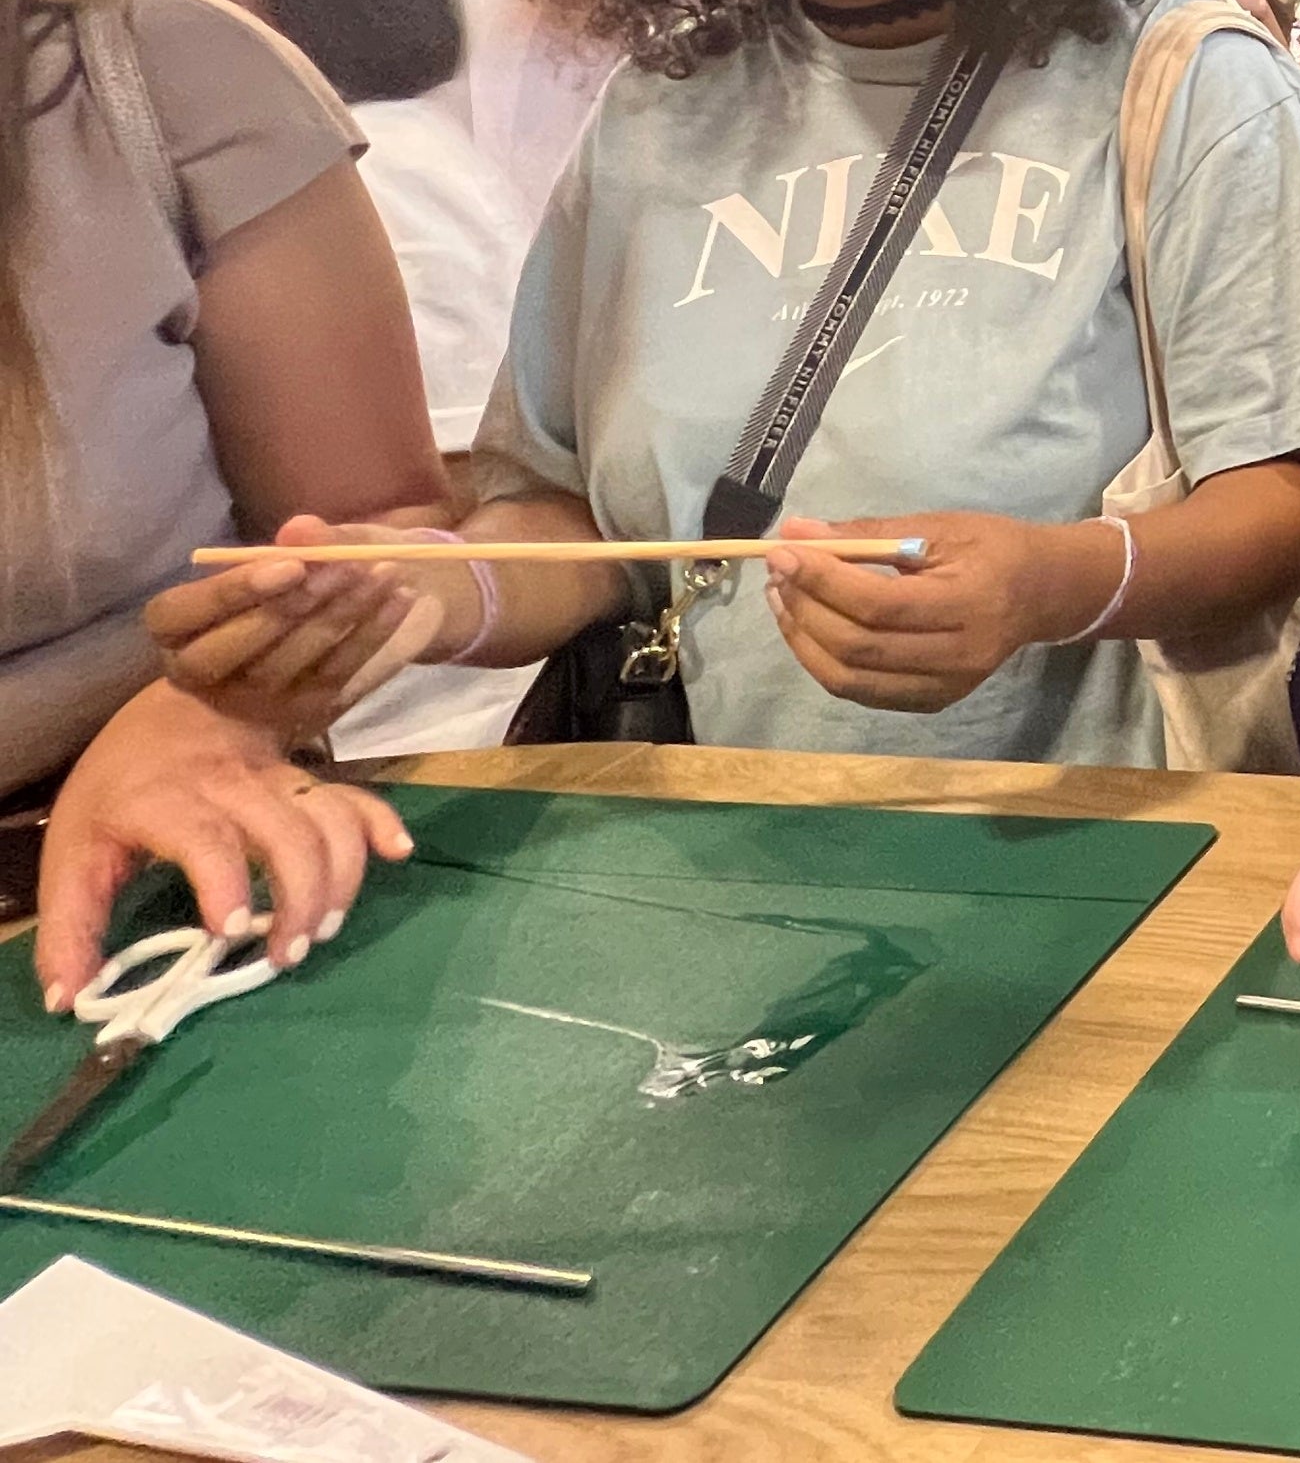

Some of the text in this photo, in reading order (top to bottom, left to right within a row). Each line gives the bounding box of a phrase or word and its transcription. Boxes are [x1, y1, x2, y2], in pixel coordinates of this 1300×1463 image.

[928, 72, 970, 131] TOMMY
[812, 295, 852, 360] TOMMY
[916, 288, 969, 308] 1972
